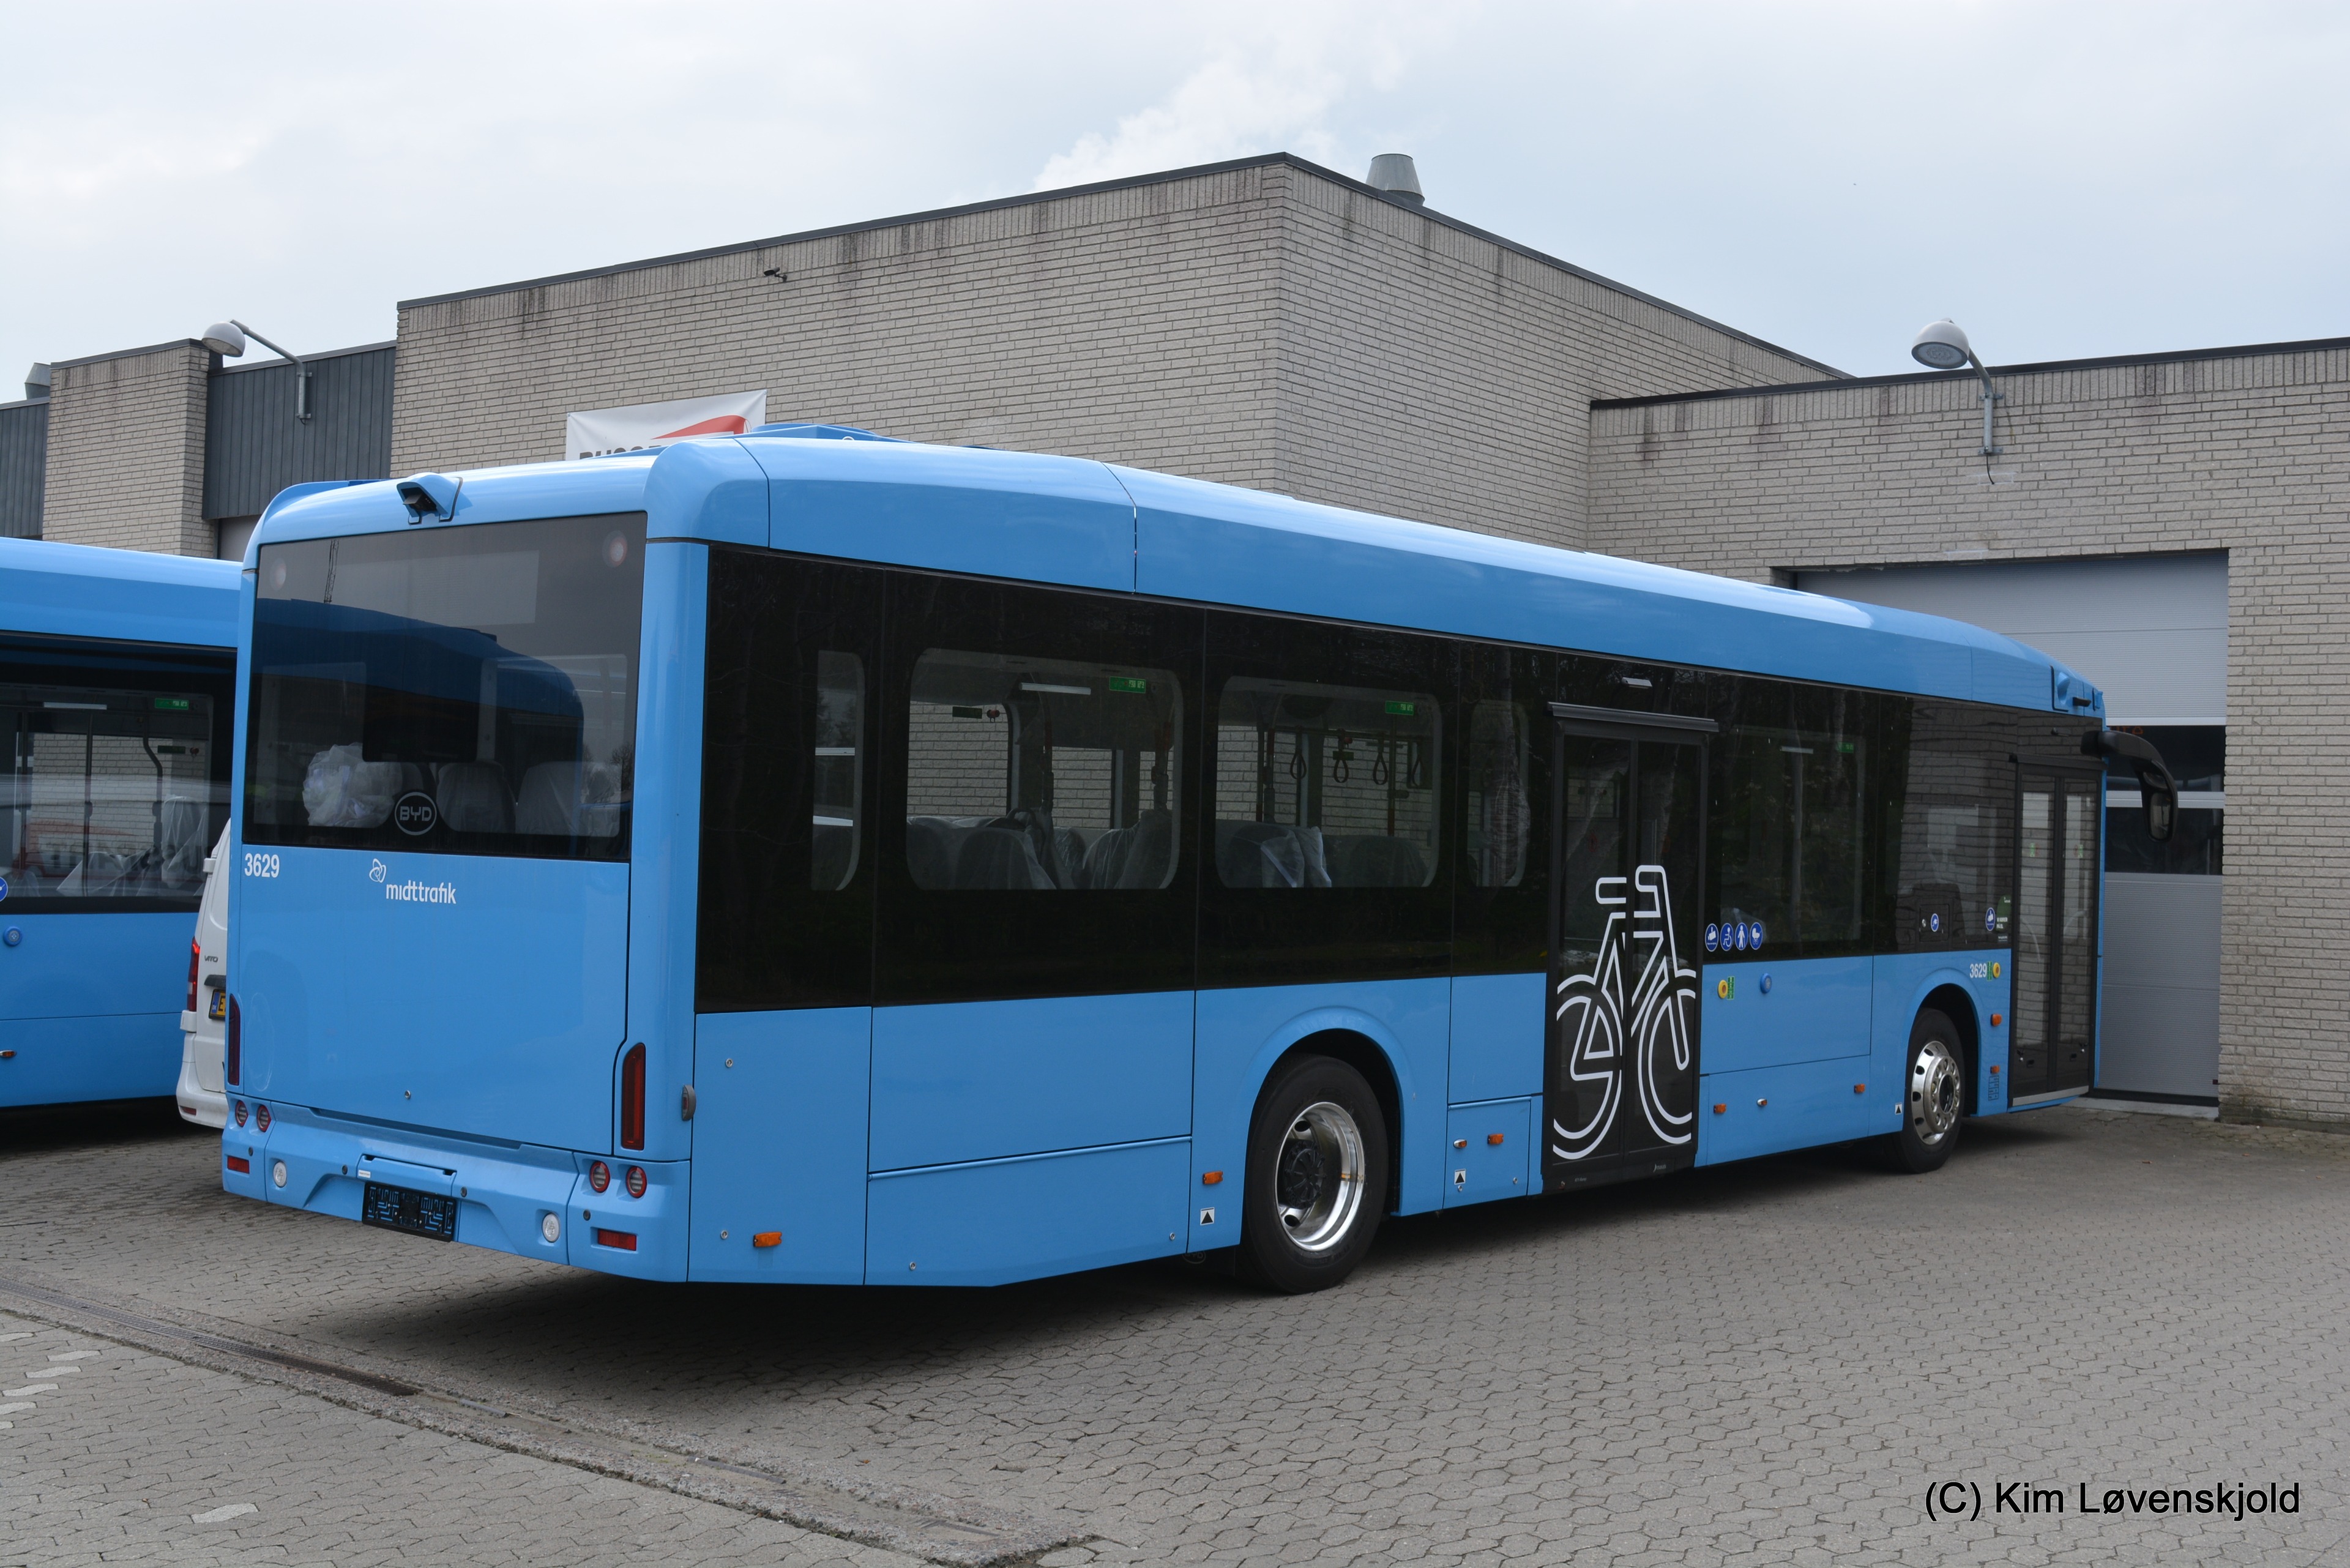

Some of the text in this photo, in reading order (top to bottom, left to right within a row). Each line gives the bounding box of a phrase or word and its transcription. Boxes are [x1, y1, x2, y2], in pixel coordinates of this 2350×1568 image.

[400, 806, 432, 821] BYD
[244, 853, 280, 878] 3629
[386, 879, 457, 904] midttrafik
[1969, 963, 1987, 978] 3629
